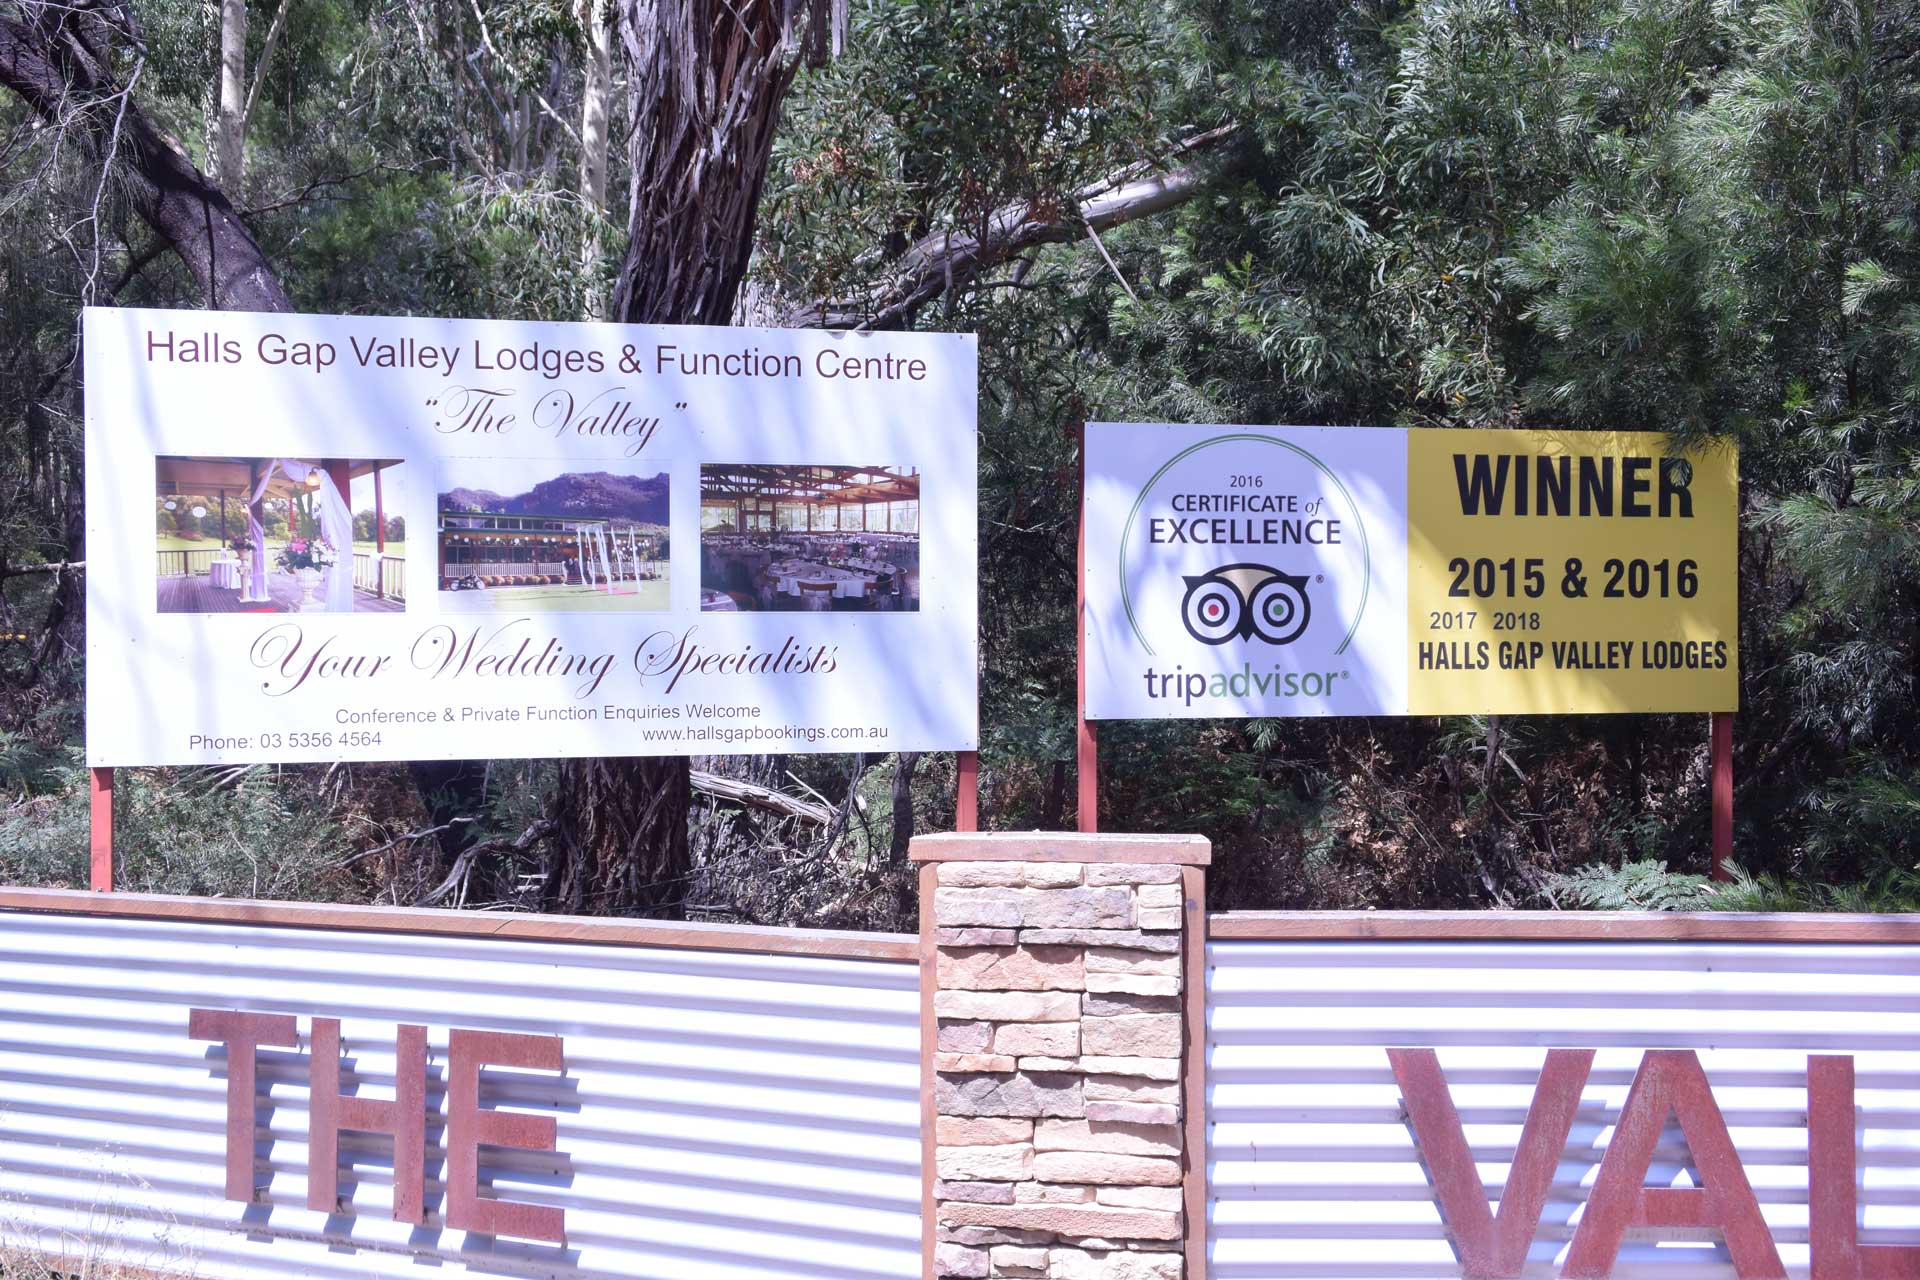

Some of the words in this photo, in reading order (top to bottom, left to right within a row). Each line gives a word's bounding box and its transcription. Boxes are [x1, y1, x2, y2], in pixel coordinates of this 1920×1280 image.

[147, 330, 242, 364] Halls
[257, 333, 336, 373] Gap
[350, 336, 460, 377] Valley
[474, 340, 604, 379] Lodges
[619, 344, 643, 374] &
[657, 345, 802, 377] Function
[815, 349, 927, 380] Centre
[1230, 475, 1263, 488] 2016
[1453, 454, 1694, 518] WINNER
[1171, 494, 1298, 512] CERTIFICATE
[1305, 498, 1323, 516] of
[1150, 518, 1341, 544] EXCELLENCE
[1448, 557, 1545, 598] 2015
[1561, 557, 1588, 597] &
[1603, 559, 1698, 598] 2016
[1430, 612, 1477, 629] 2017
[1493, 612, 1540, 630] 2018
[249, 623, 392, 697] Your
[410, 617, 617, 700] Wedding
[633, 625, 839, 694] Specialists
[1419, 641, 1489, 670] HALLS
[1499, 641, 1543, 669] GAP
[1552, 641, 1633, 669] VALLEY
[1642, 640, 1727, 669] LODGES
[335, 708, 437, 724] Conference
[442, 707, 456, 723] &
[461, 705, 520, 722] Private
[526, 705, 598, 721] Function
[603, 704, 680, 723] Enquiries
[685, 703, 761, 718] Welcome
[189, 734, 254, 750] Phone:
[259, 733, 283, 749] 03
[288, 732, 333, 748] 5356
[338, 731, 382, 747] 4564
[642, 725, 889, 743] www.hallsgapbookings.com.au
[188, 1008, 565, 1243] THE
